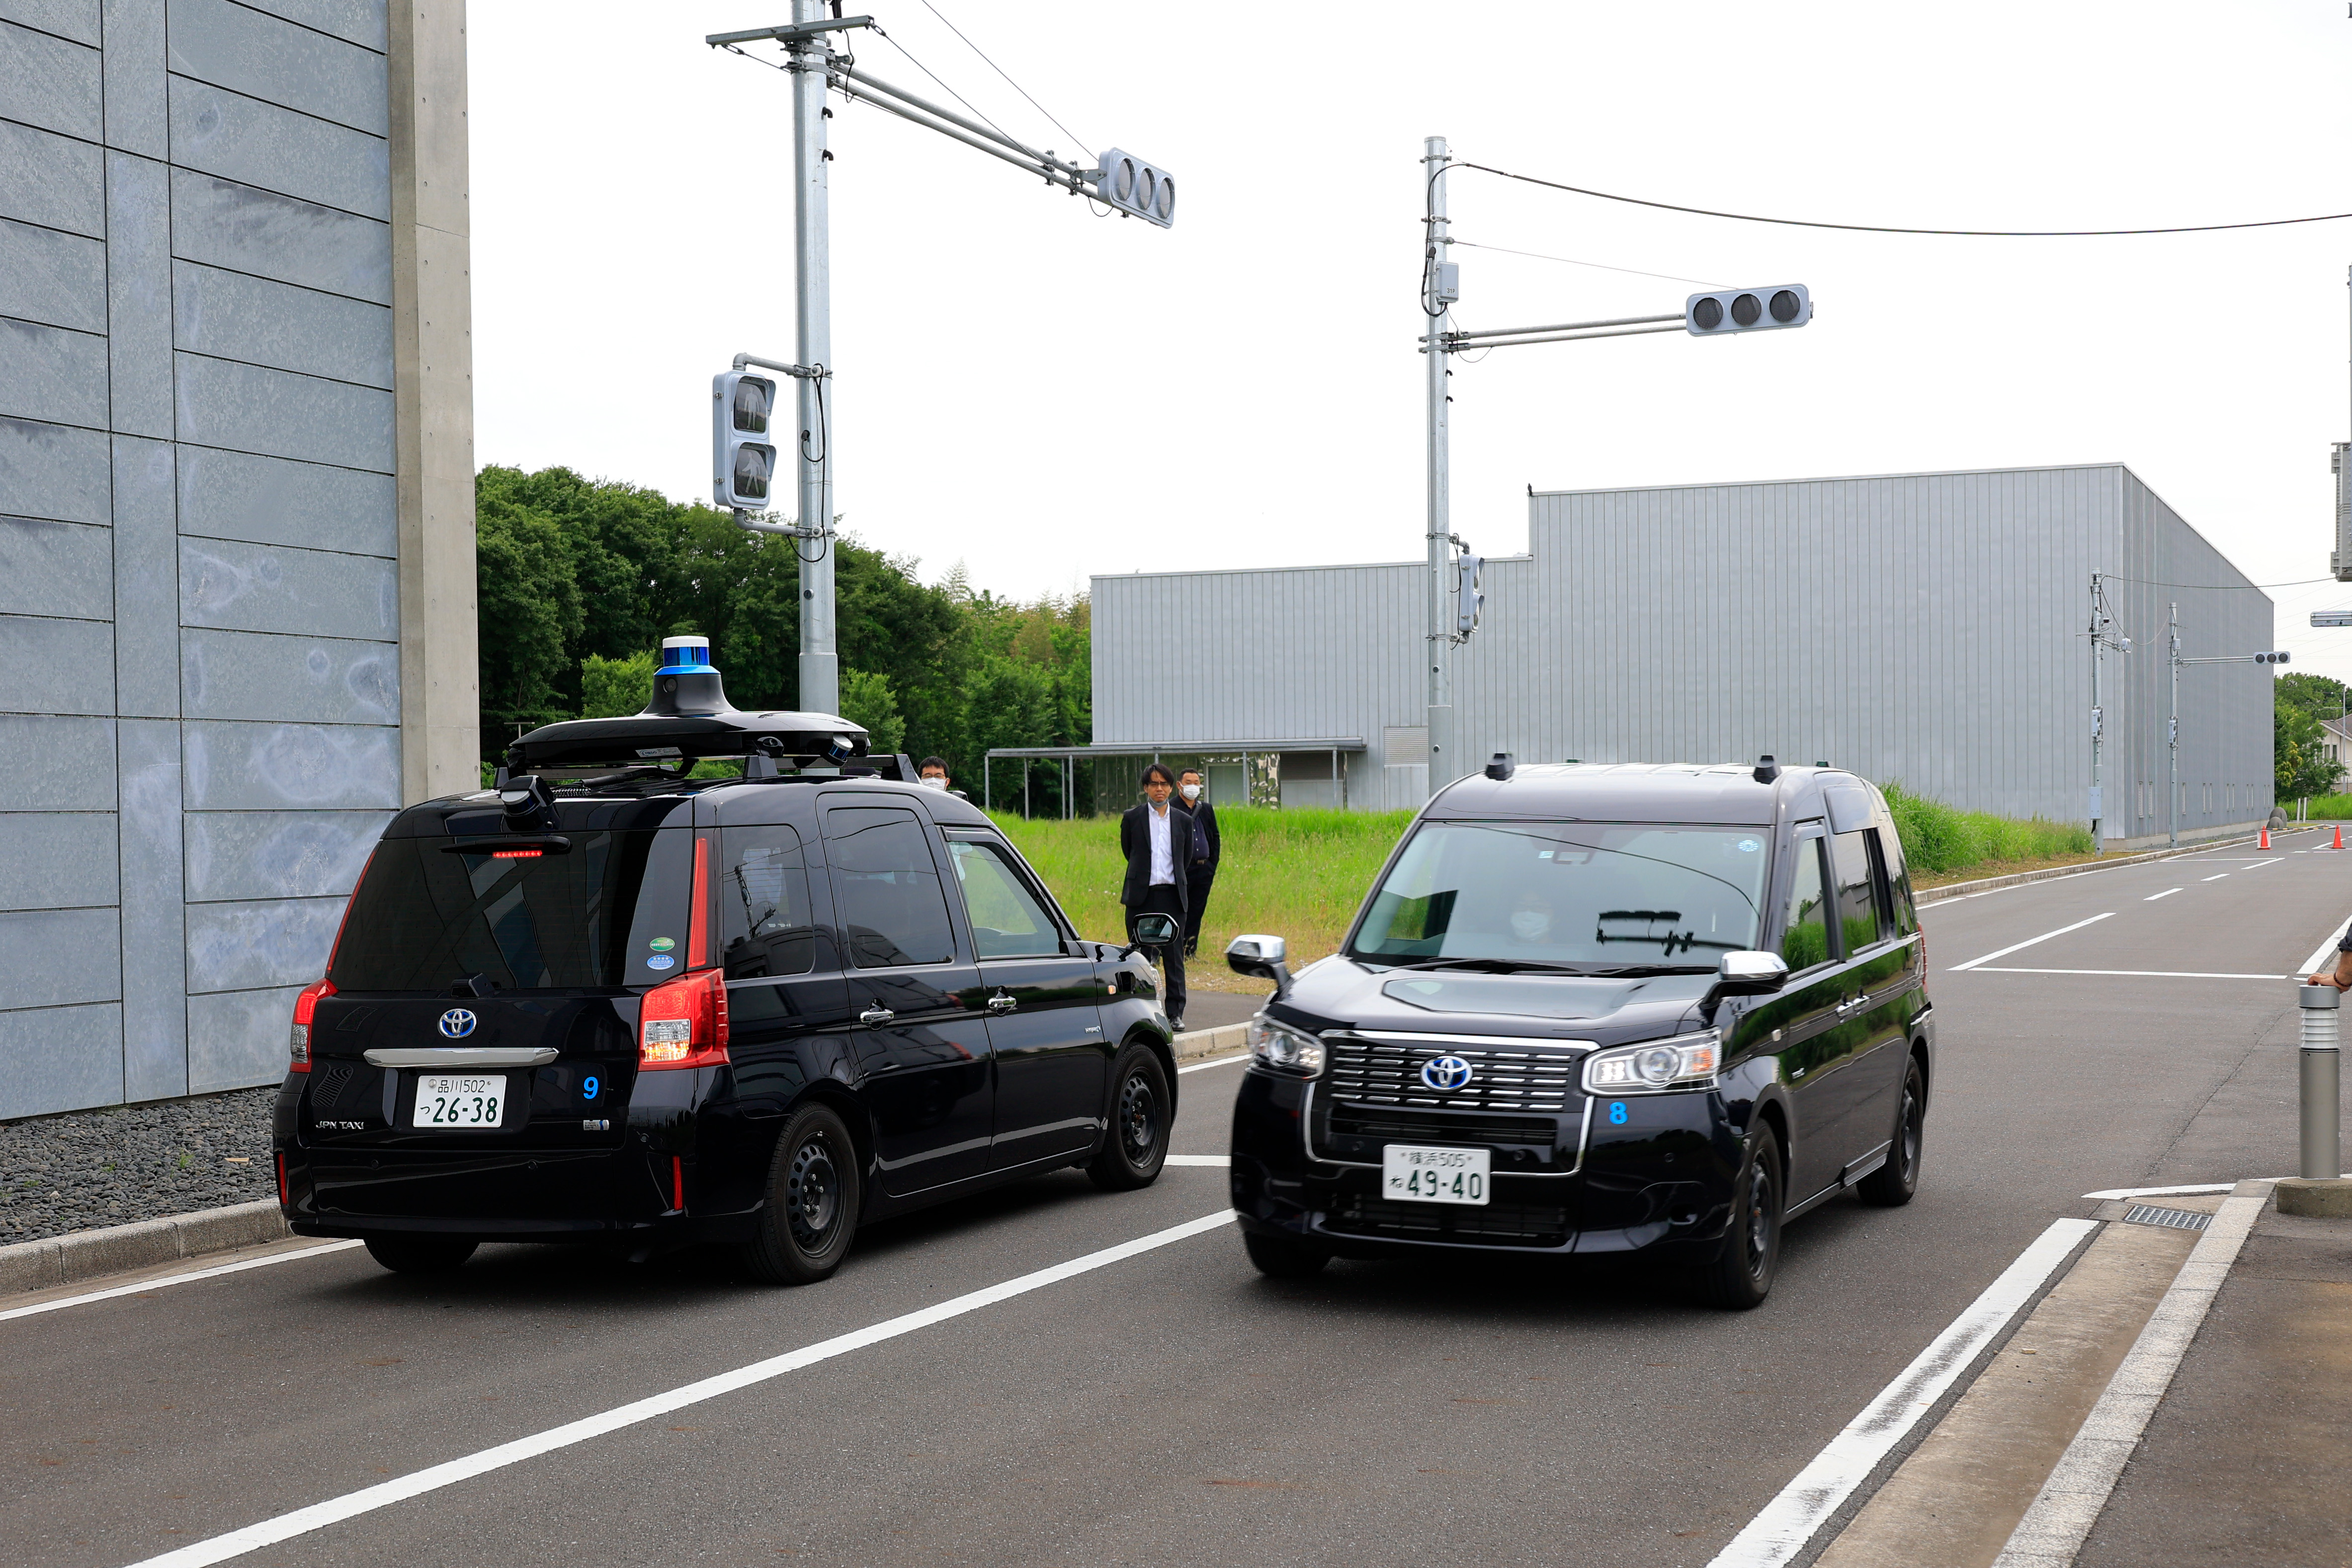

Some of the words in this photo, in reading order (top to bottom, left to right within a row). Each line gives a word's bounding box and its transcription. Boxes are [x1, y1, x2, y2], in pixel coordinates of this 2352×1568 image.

[584, 1076, 598, 1099] 9
[432, 1097, 498, 1123] 26-38
[1609, 1101, 1628, 1125] 8
[1407, 1169, 1481, 1199] 49-40
